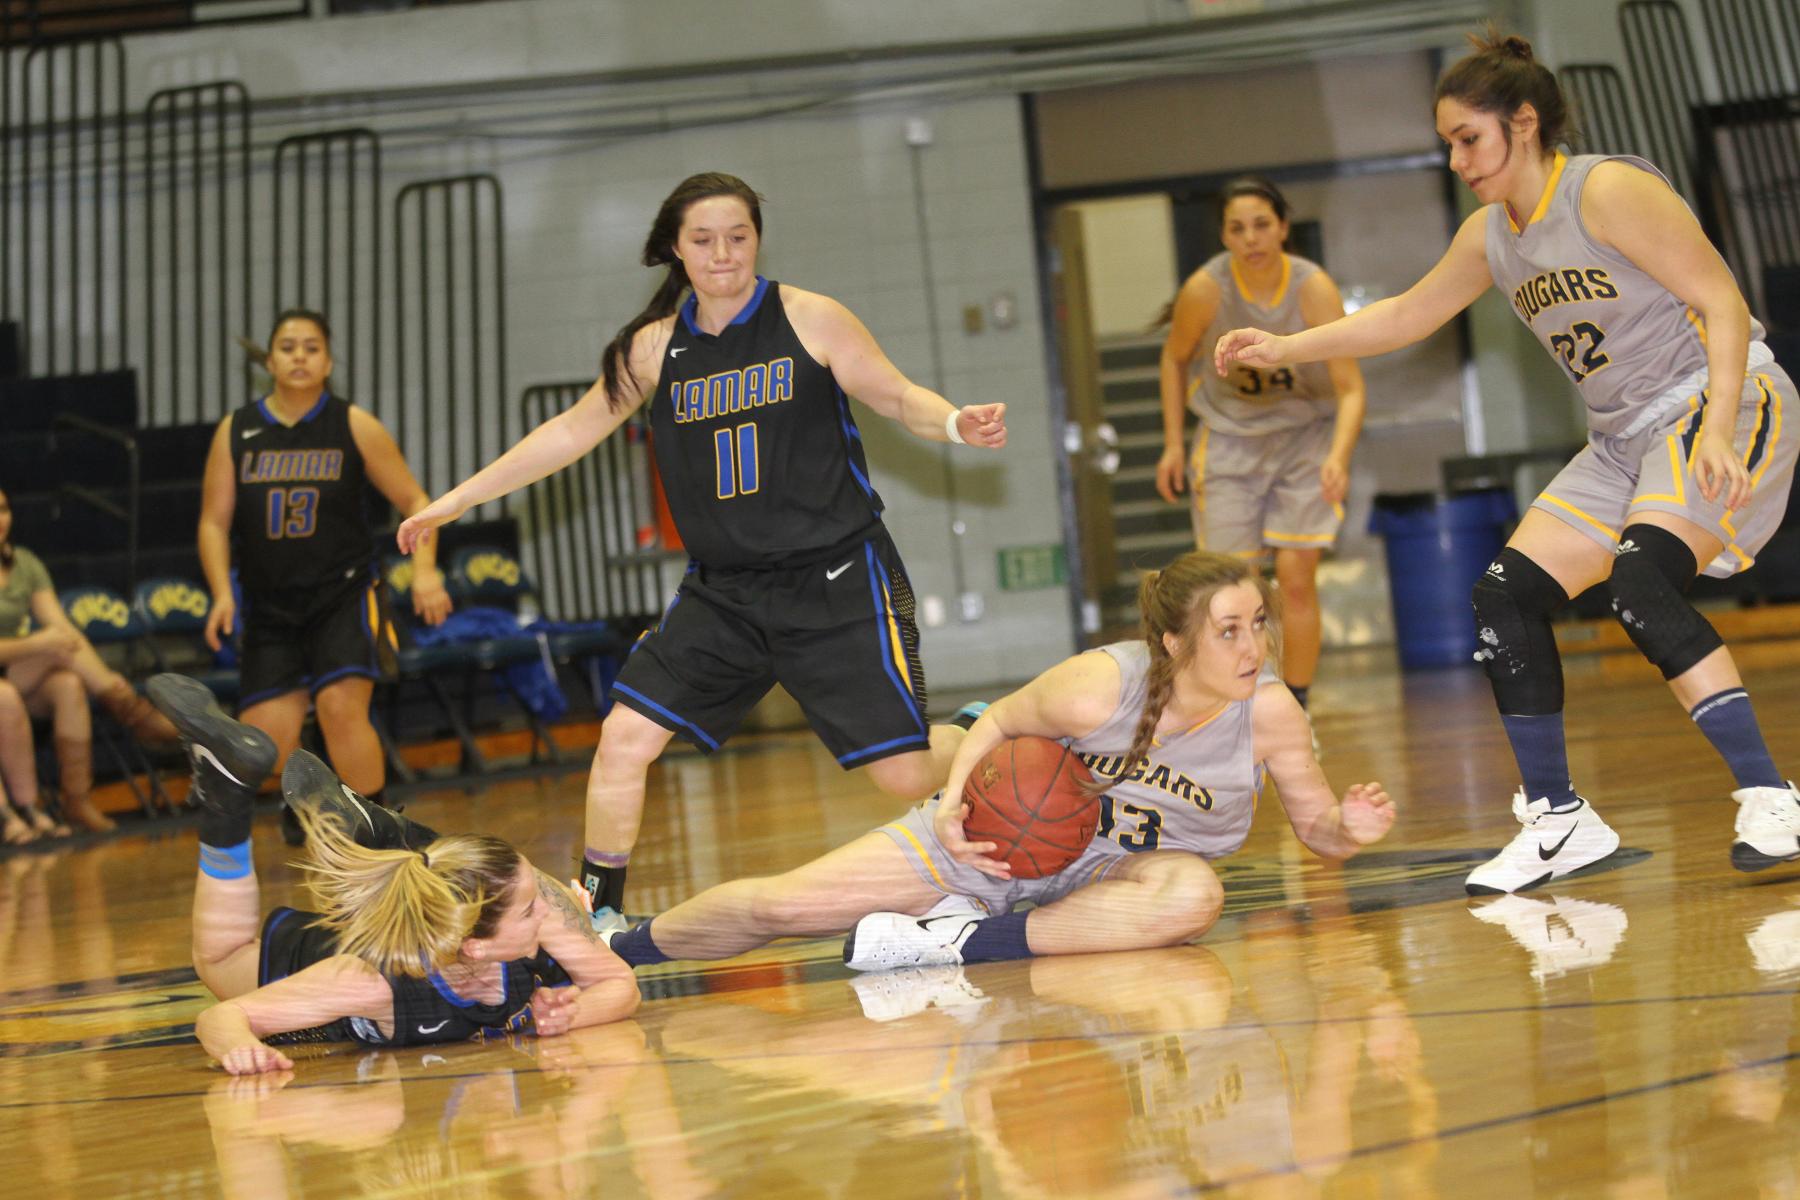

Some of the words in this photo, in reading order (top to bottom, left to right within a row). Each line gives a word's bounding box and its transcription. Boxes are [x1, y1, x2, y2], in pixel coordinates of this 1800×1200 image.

[1514, 267, 1619, 322] OUGARS
[1549, 320, 1610, 383] 22
[671, 357, 793, 423] LAMAR
[241, 449, 344, 483] LAMAR
[714, 422, 758, 499] 11
[266, 487, 320, 540] 13
[1079, 751, 1215, 812] UGARS
[1097, 794, 1163, 853] 13
